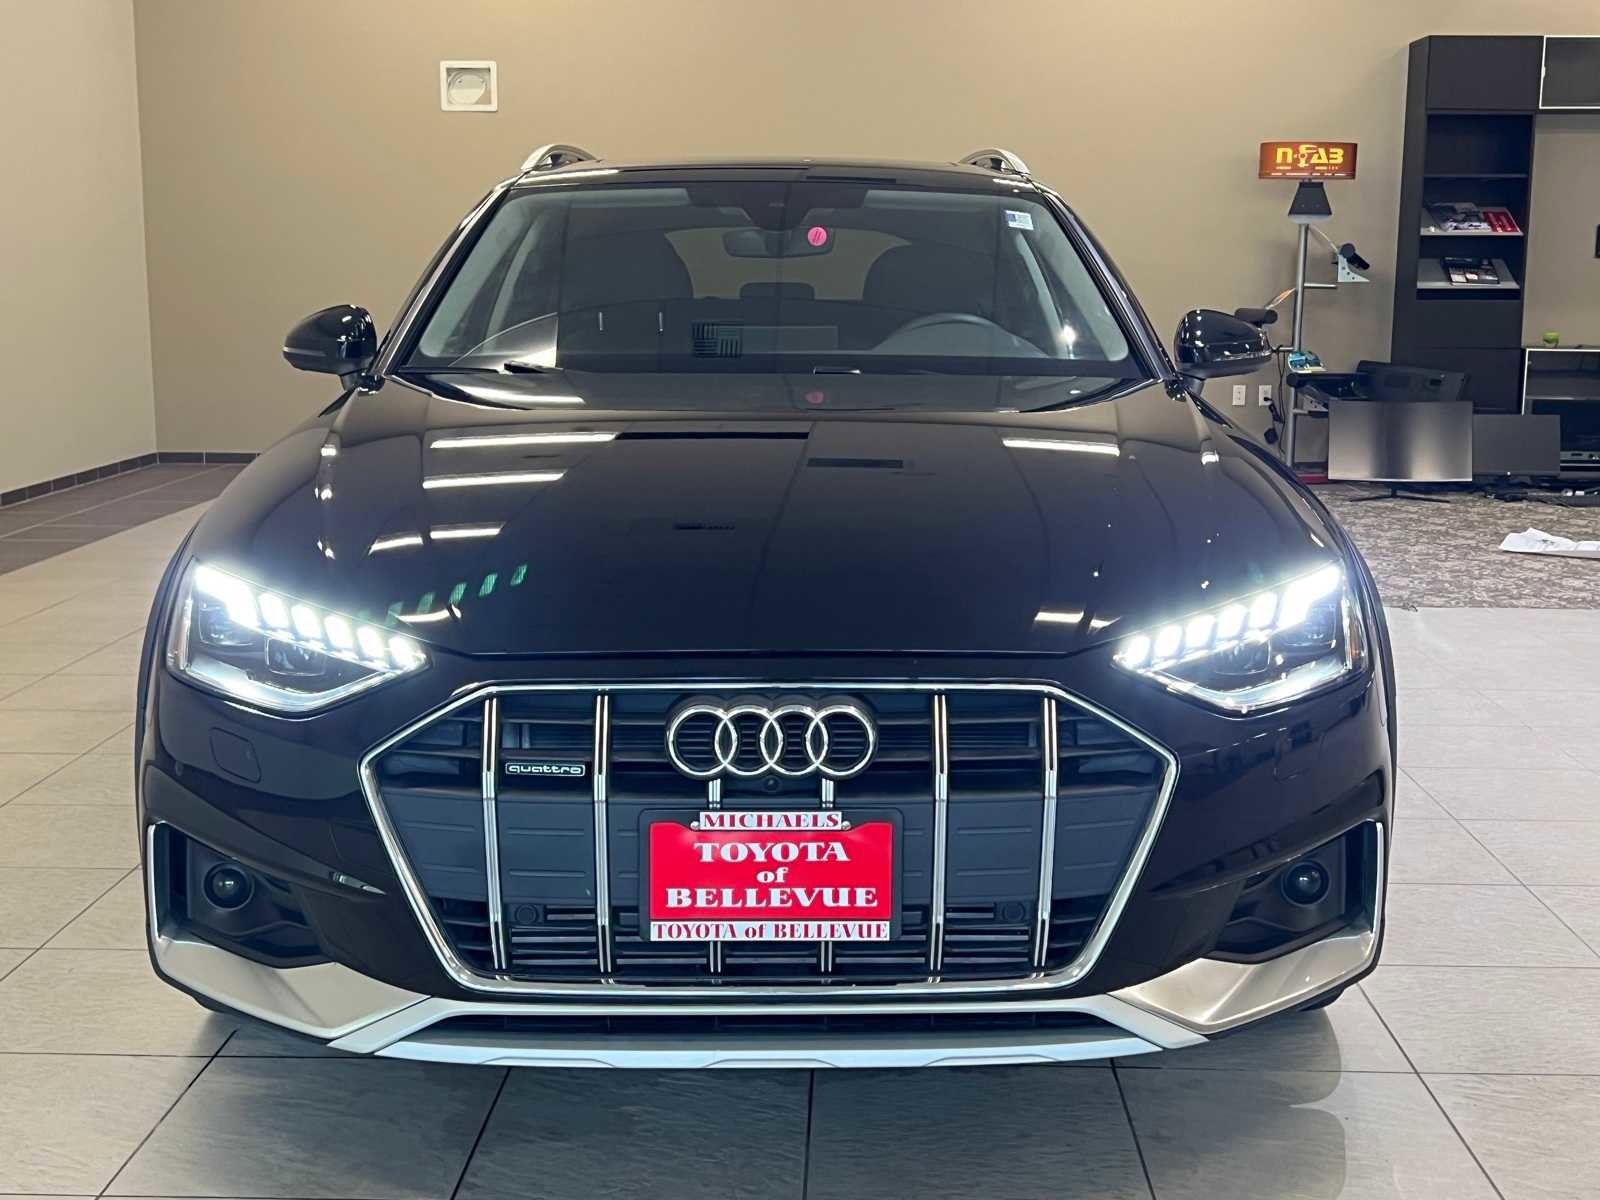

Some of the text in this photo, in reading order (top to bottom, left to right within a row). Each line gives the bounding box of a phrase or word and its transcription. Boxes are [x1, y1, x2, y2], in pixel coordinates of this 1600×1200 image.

[508, 765, 582, 774] quattro
[703, 813, 840, 828] MICHAELS
[694, 842, 851, 863] TOYOTA
[756, 867, 789, 884] of
[665, 887, 878, 908] BELLEVUE
[653, 923, 887, 939] TOYOTA of BELLEVUE
